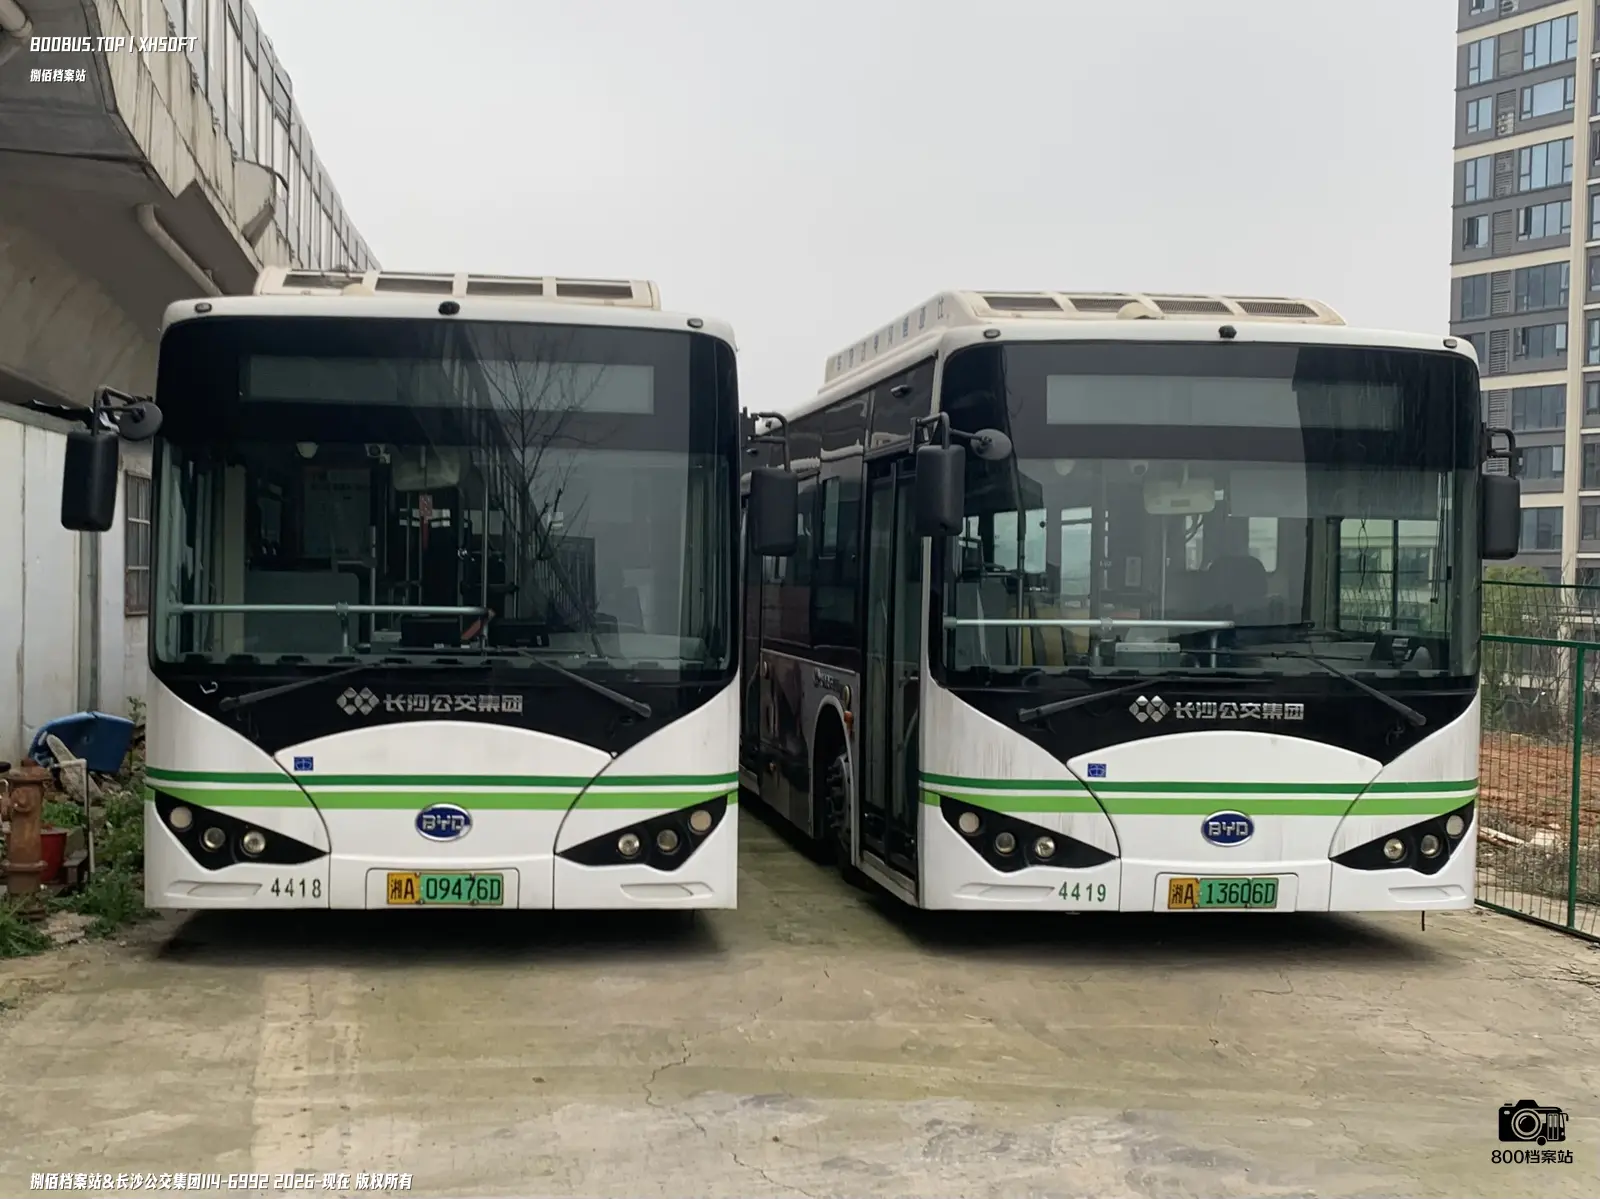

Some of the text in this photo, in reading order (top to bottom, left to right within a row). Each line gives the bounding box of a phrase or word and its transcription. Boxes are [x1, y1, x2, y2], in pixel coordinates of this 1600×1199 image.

[383, 693, 524, 713] 长沙公交集团
[1174, 701, 1305, 721] 长沙公交集团
[422, 814, 465, 831] BYD
[1208, 821, 1249, 836] BYD
[270, 877, 322, 899] 4418
[1058, 881, 1107, 903] 4419
